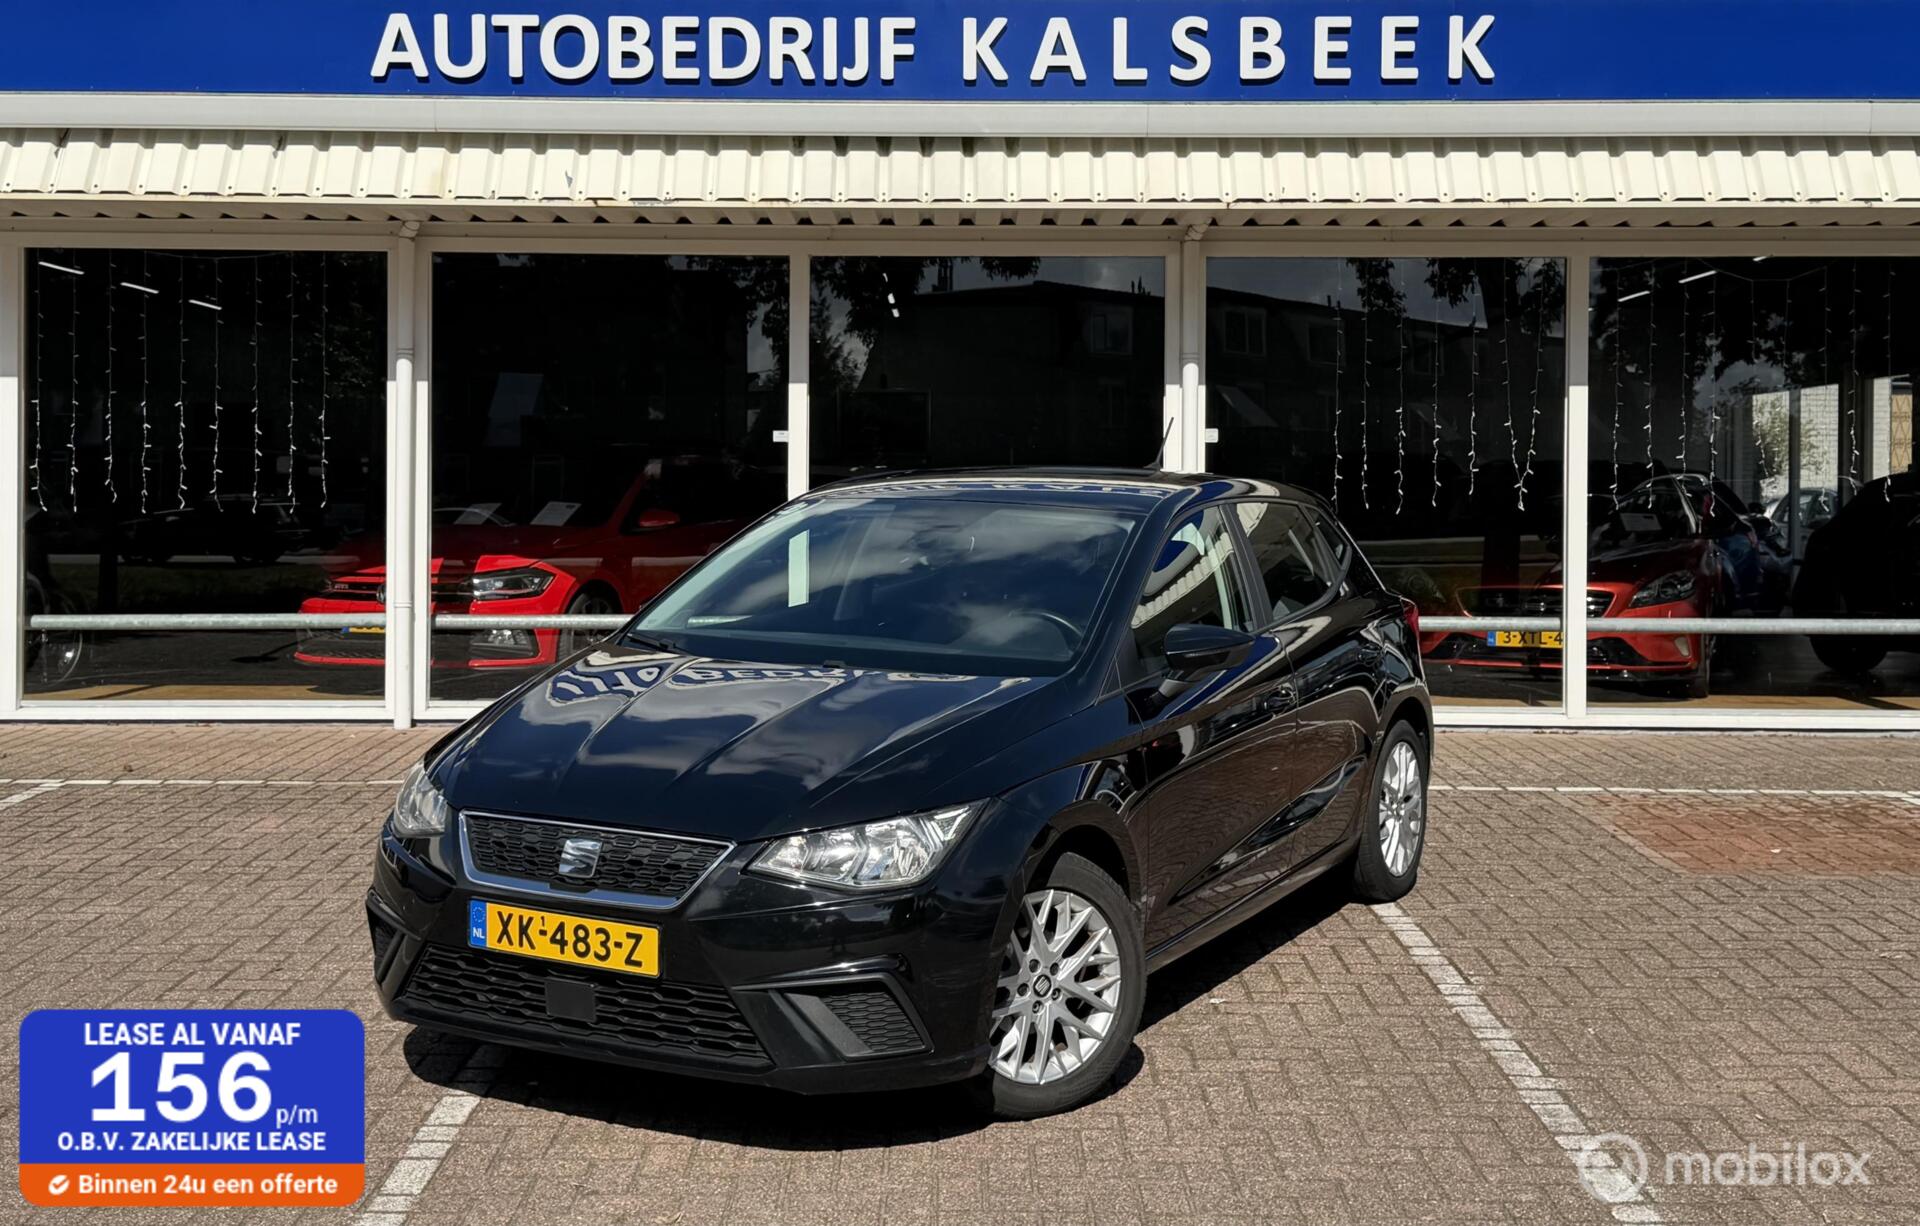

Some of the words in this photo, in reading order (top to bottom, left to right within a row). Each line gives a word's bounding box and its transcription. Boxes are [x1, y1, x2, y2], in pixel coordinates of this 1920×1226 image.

[370, 13, 916, 81] AUTOBEDRIJF
[962, 15, 1495, 81] KALSBEEK
[473, 927, 485, 939] NL
[496, 910, 644, 968] XK-483-Z
